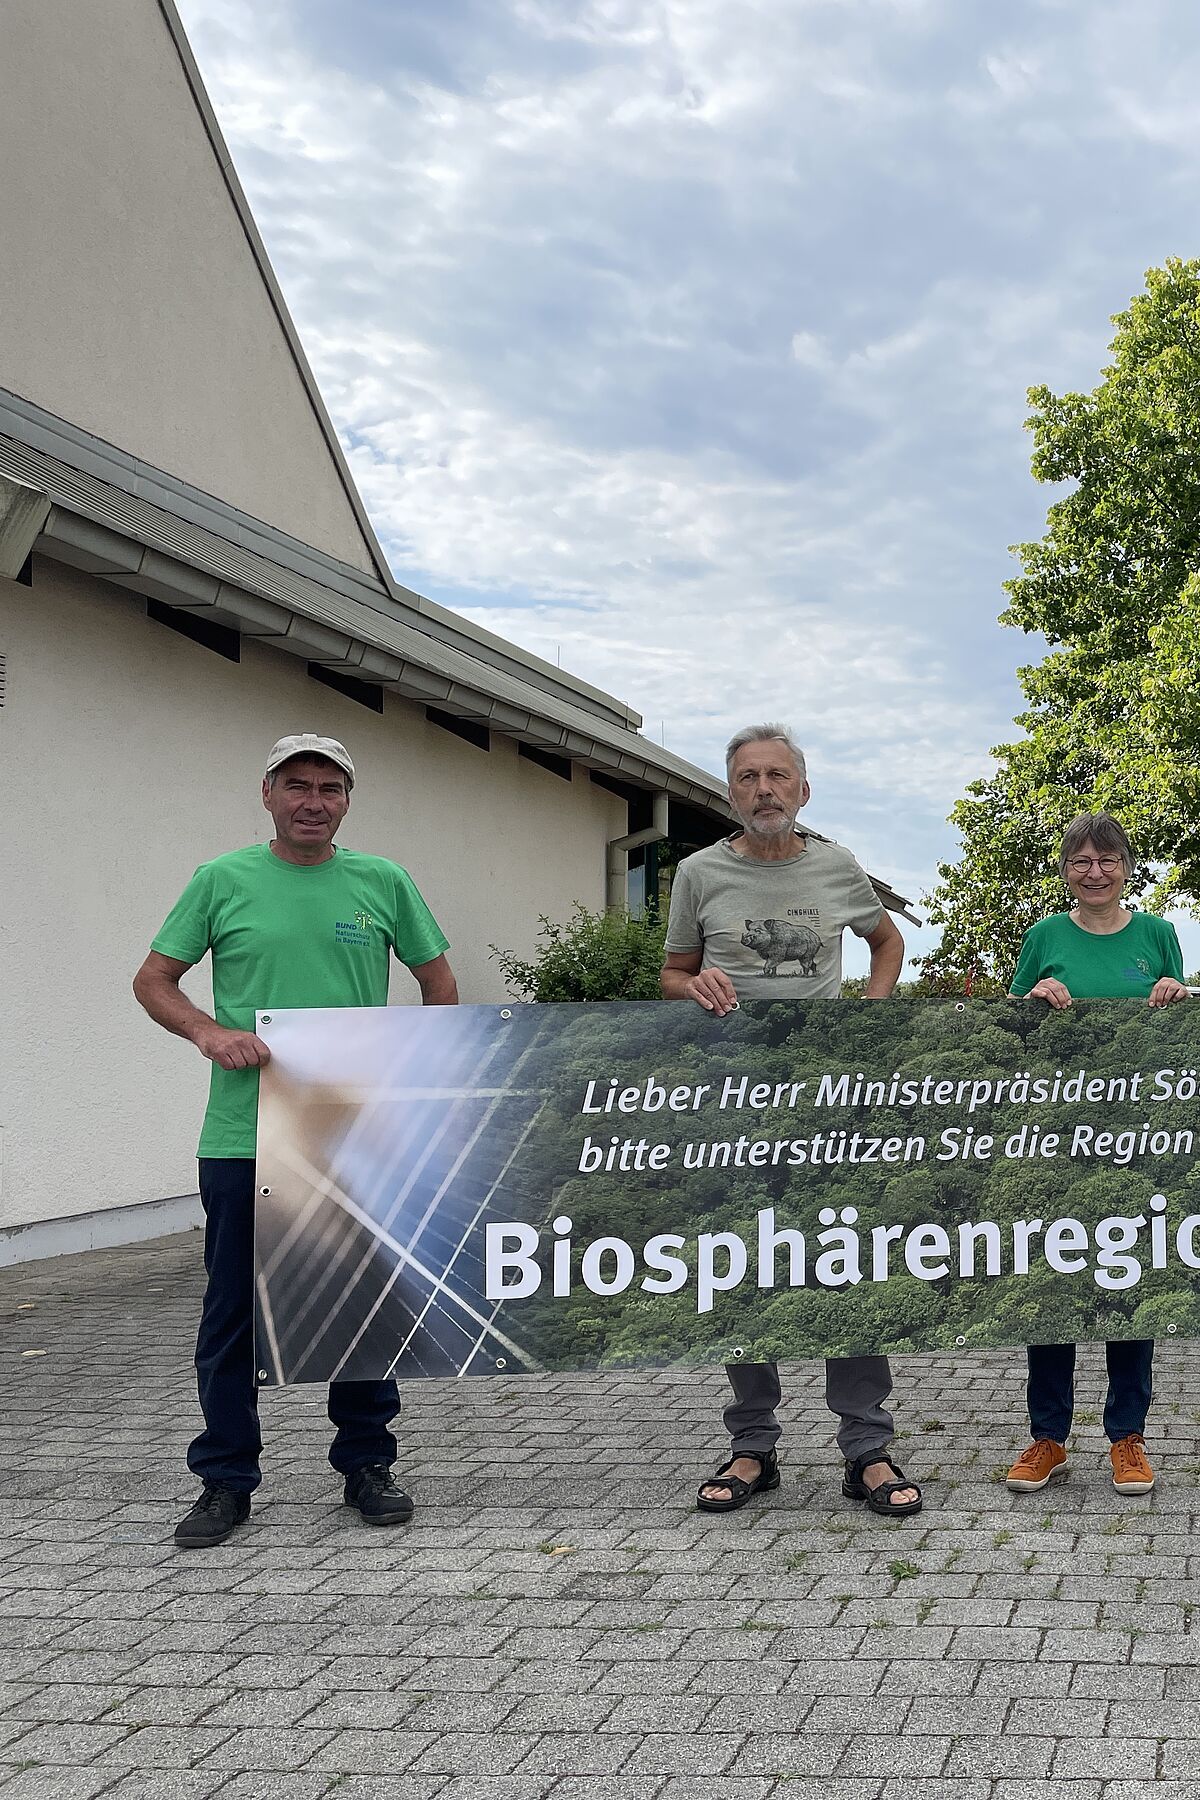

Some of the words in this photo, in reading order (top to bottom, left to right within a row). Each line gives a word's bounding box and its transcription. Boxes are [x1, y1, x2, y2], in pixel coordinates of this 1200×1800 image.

[787, 908, 820, 917] CINGHIALE
[336, 922, 357, 930] BUND
[581, 1076, 711, 1114] Lieber
[718, 1075, 807, 1110] Herr
[814, 1070, 1143, 1113] Ministerpräsident
[577, 1136, 672, 1173] bitte
[682, 1130, 926, 1169] unterstützen
[935, 1126, 993, 1161] Sie
[1004, 1124, 1060, 1159] die
[1070, 1122, 1194, 1165] Region
